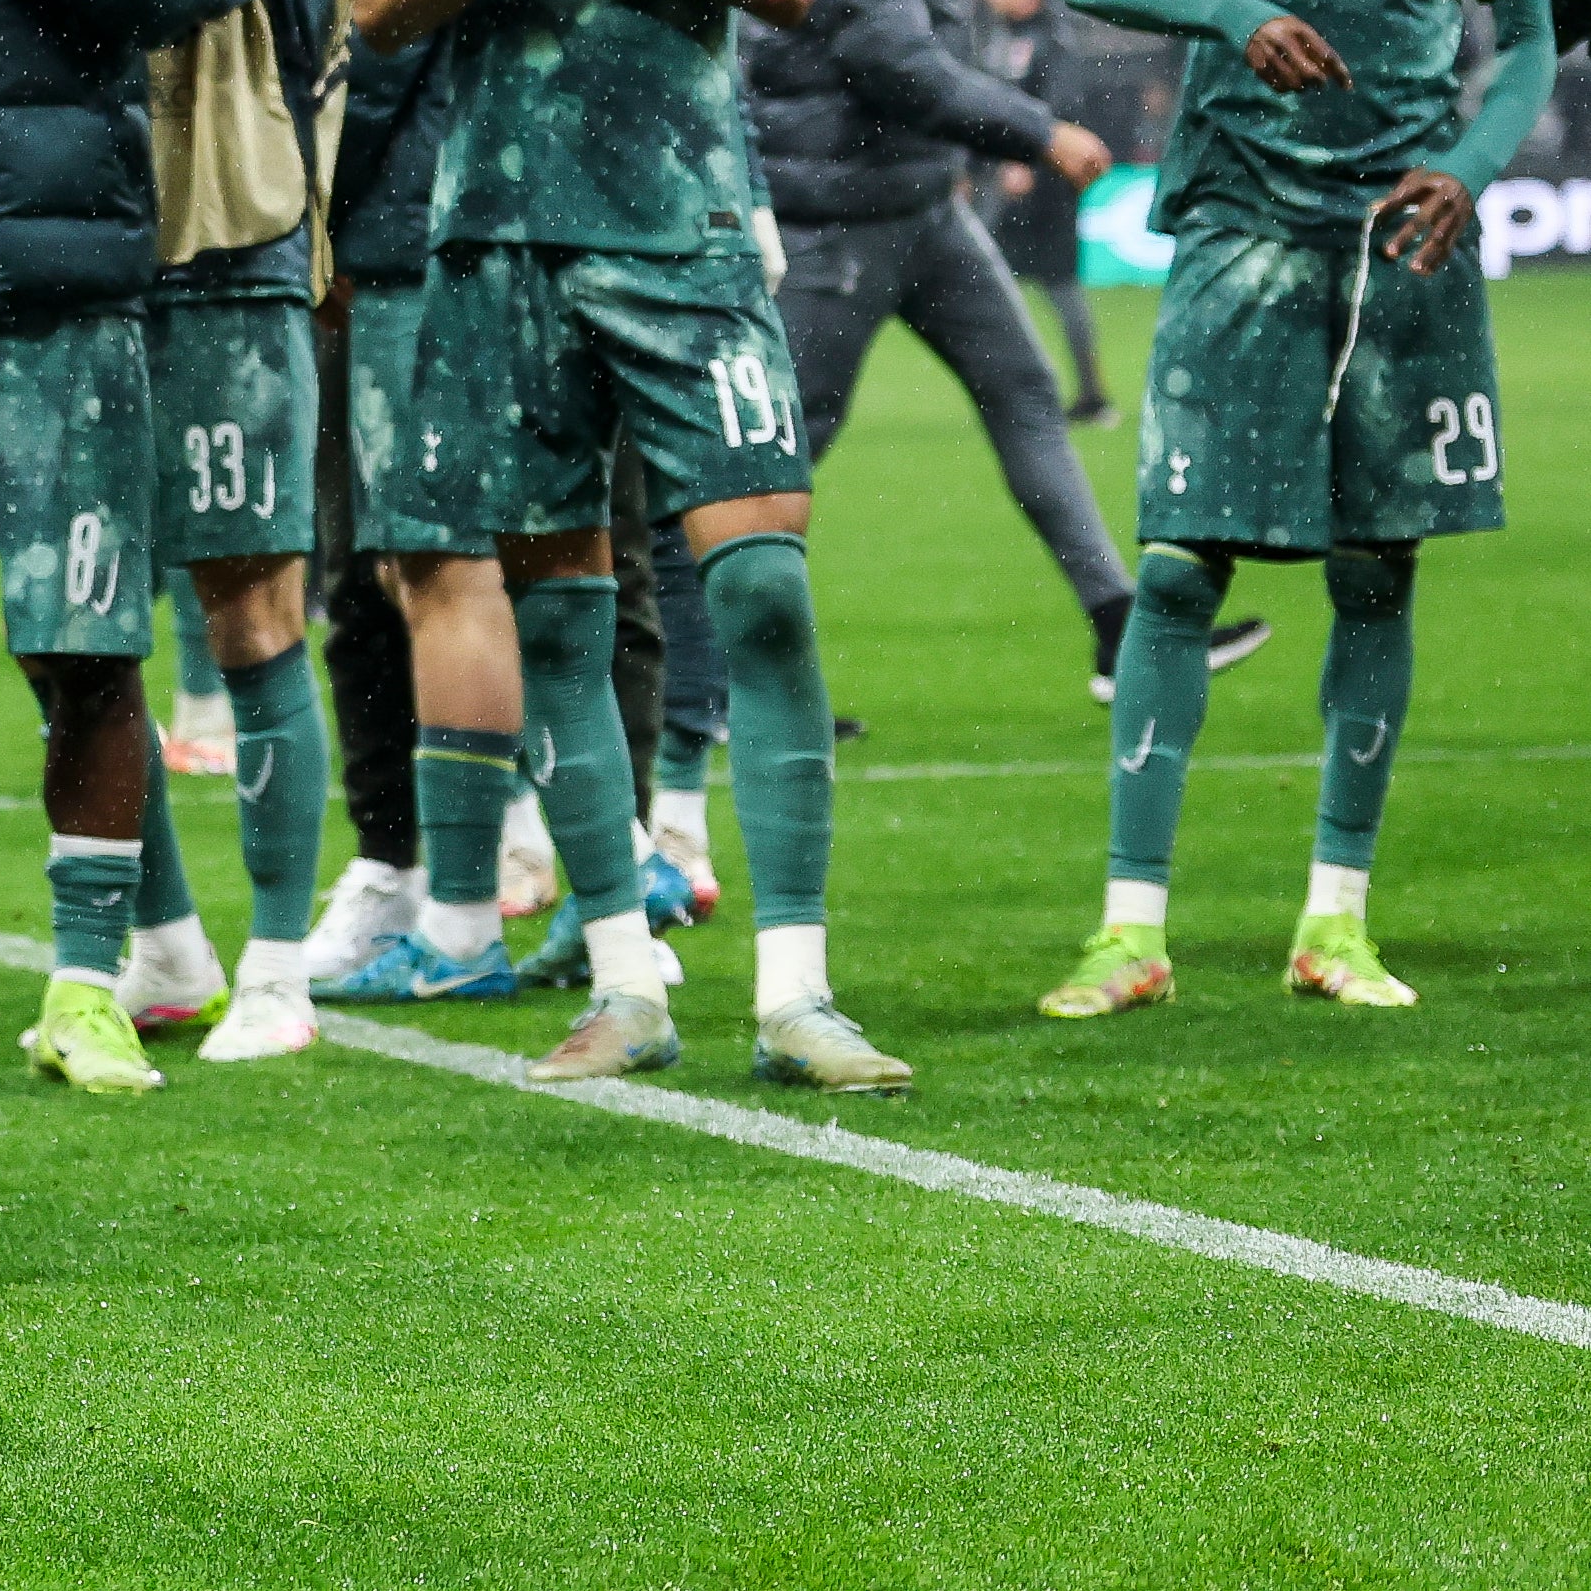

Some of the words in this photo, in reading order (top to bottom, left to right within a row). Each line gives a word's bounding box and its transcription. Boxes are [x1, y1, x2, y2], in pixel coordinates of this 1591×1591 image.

[708, 355, 776, 448] 19
[1427, 392, 1499, 485] 29
[184, 421, 246, 514] 33
[65, 512, 102, 605] 8
